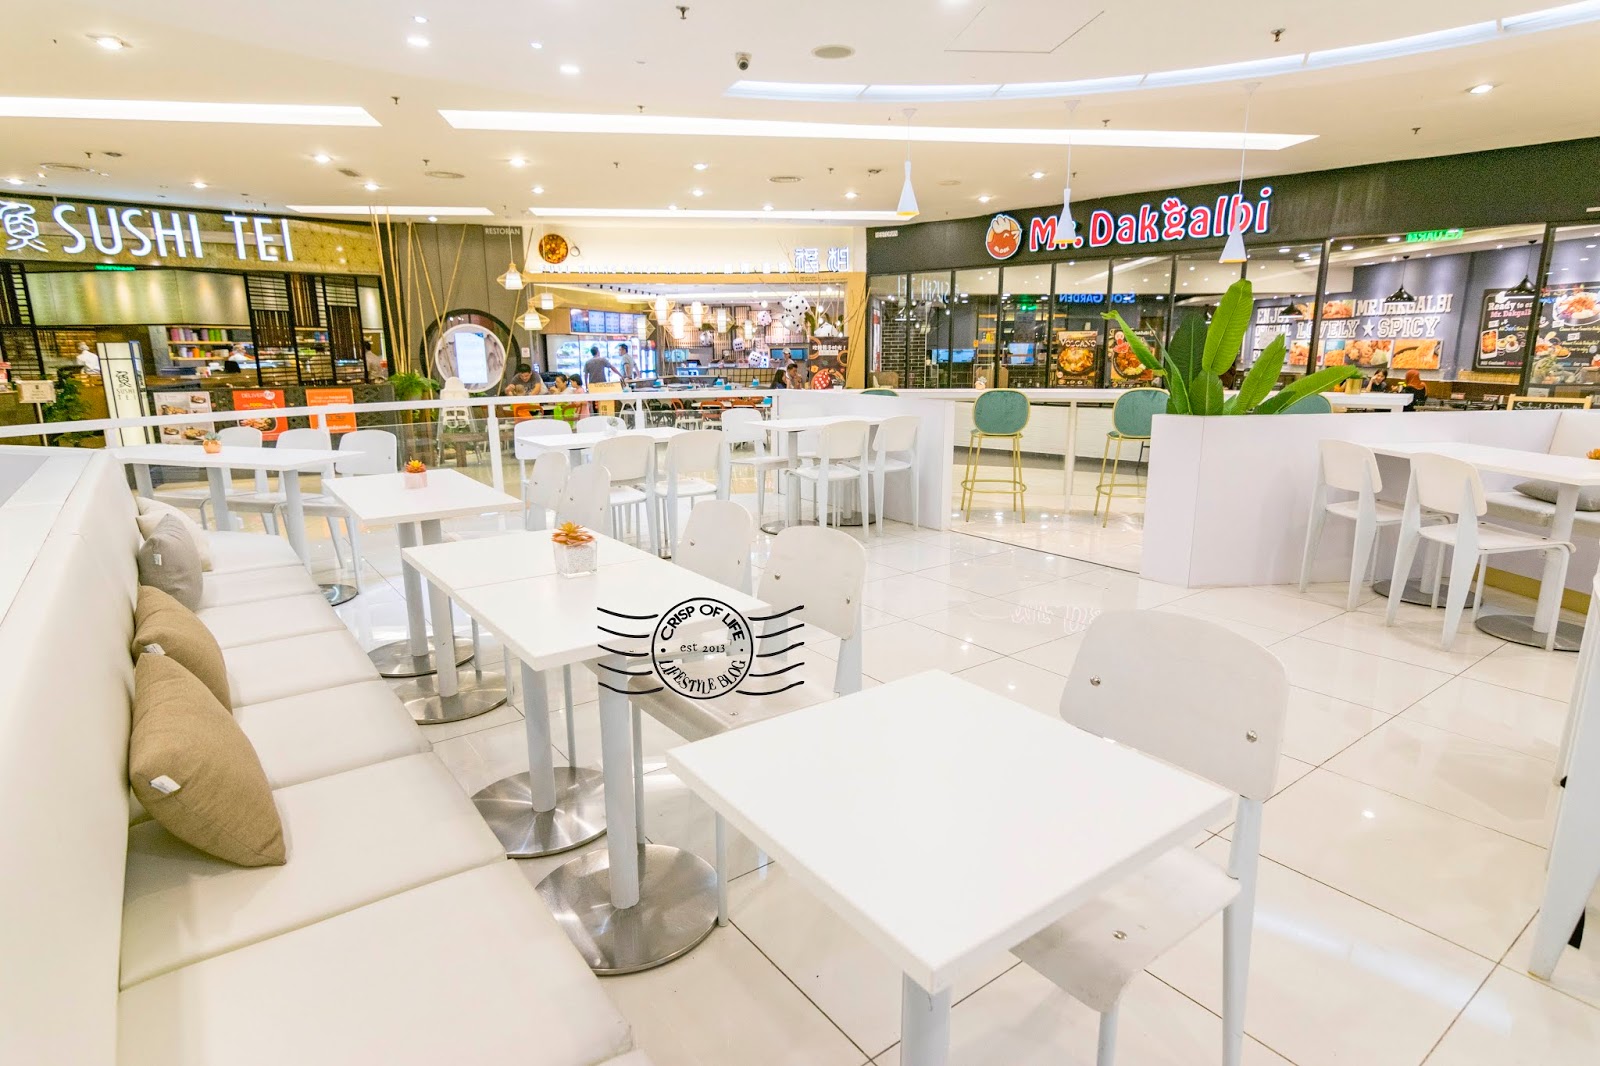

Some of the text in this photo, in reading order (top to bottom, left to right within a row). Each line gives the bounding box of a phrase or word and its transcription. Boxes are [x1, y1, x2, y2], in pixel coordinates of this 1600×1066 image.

[52, 204, 204, 259] SUSHI
[223, 214, 294, 263] TEI
[484, 227, 521, 235] RESTORAN
[1088, 187, 1273, 248] Dakgalbi
[1376, 315, 1441, 338] SPICY
